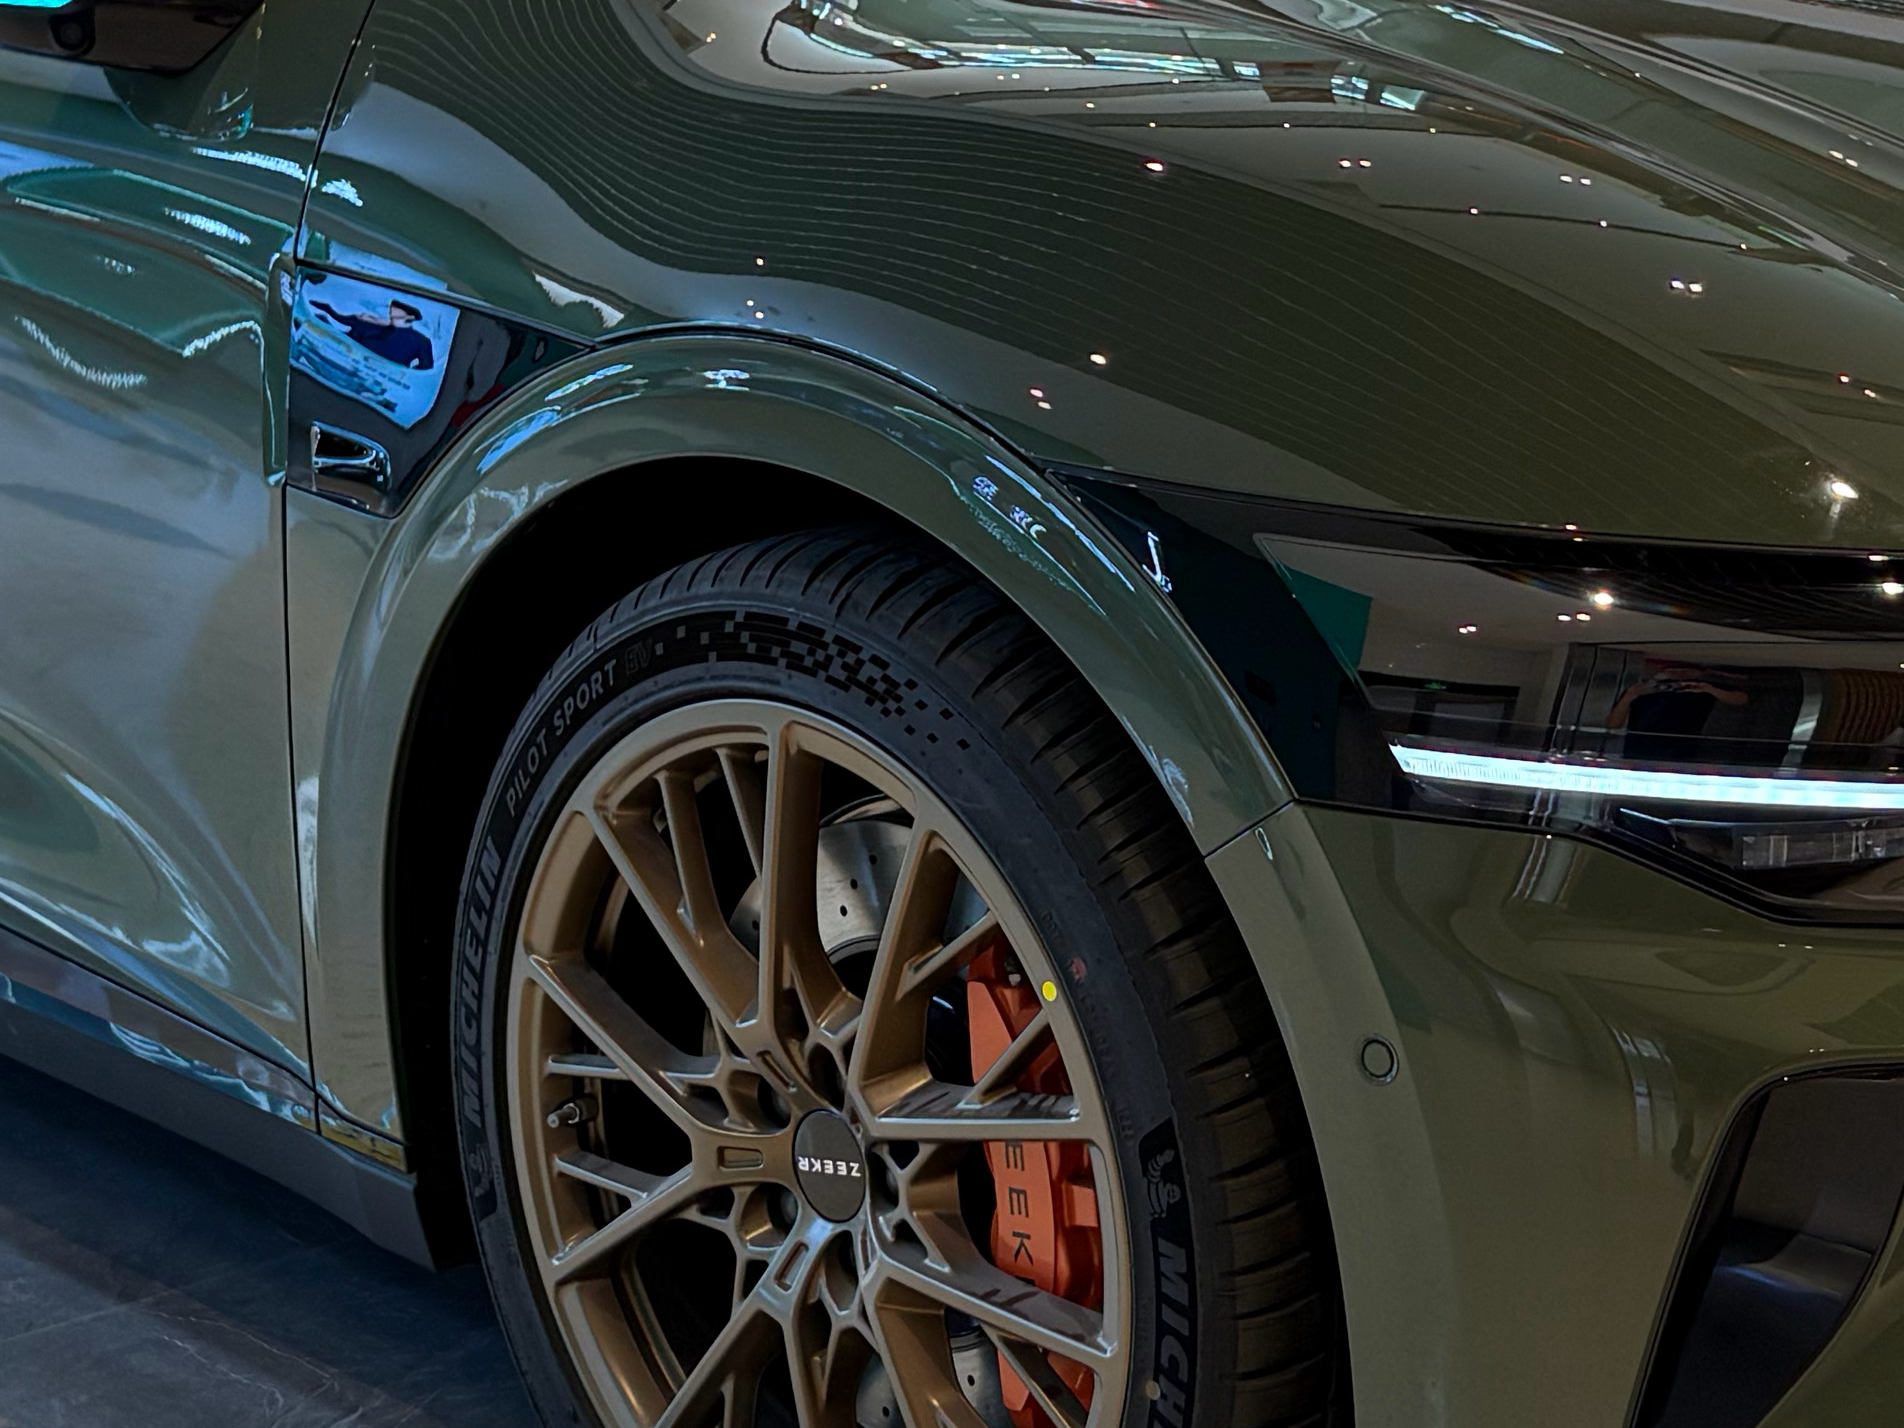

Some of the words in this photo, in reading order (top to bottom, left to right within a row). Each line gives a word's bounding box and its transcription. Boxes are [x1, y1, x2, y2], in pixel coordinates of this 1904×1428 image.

[506, 728, 548, 817] PILOT
[553, 658, 617, 736] SPORT
[459, 834, 502, 1129] MICHELIN
[797, 1155, 862, 1178] ZEEKR
